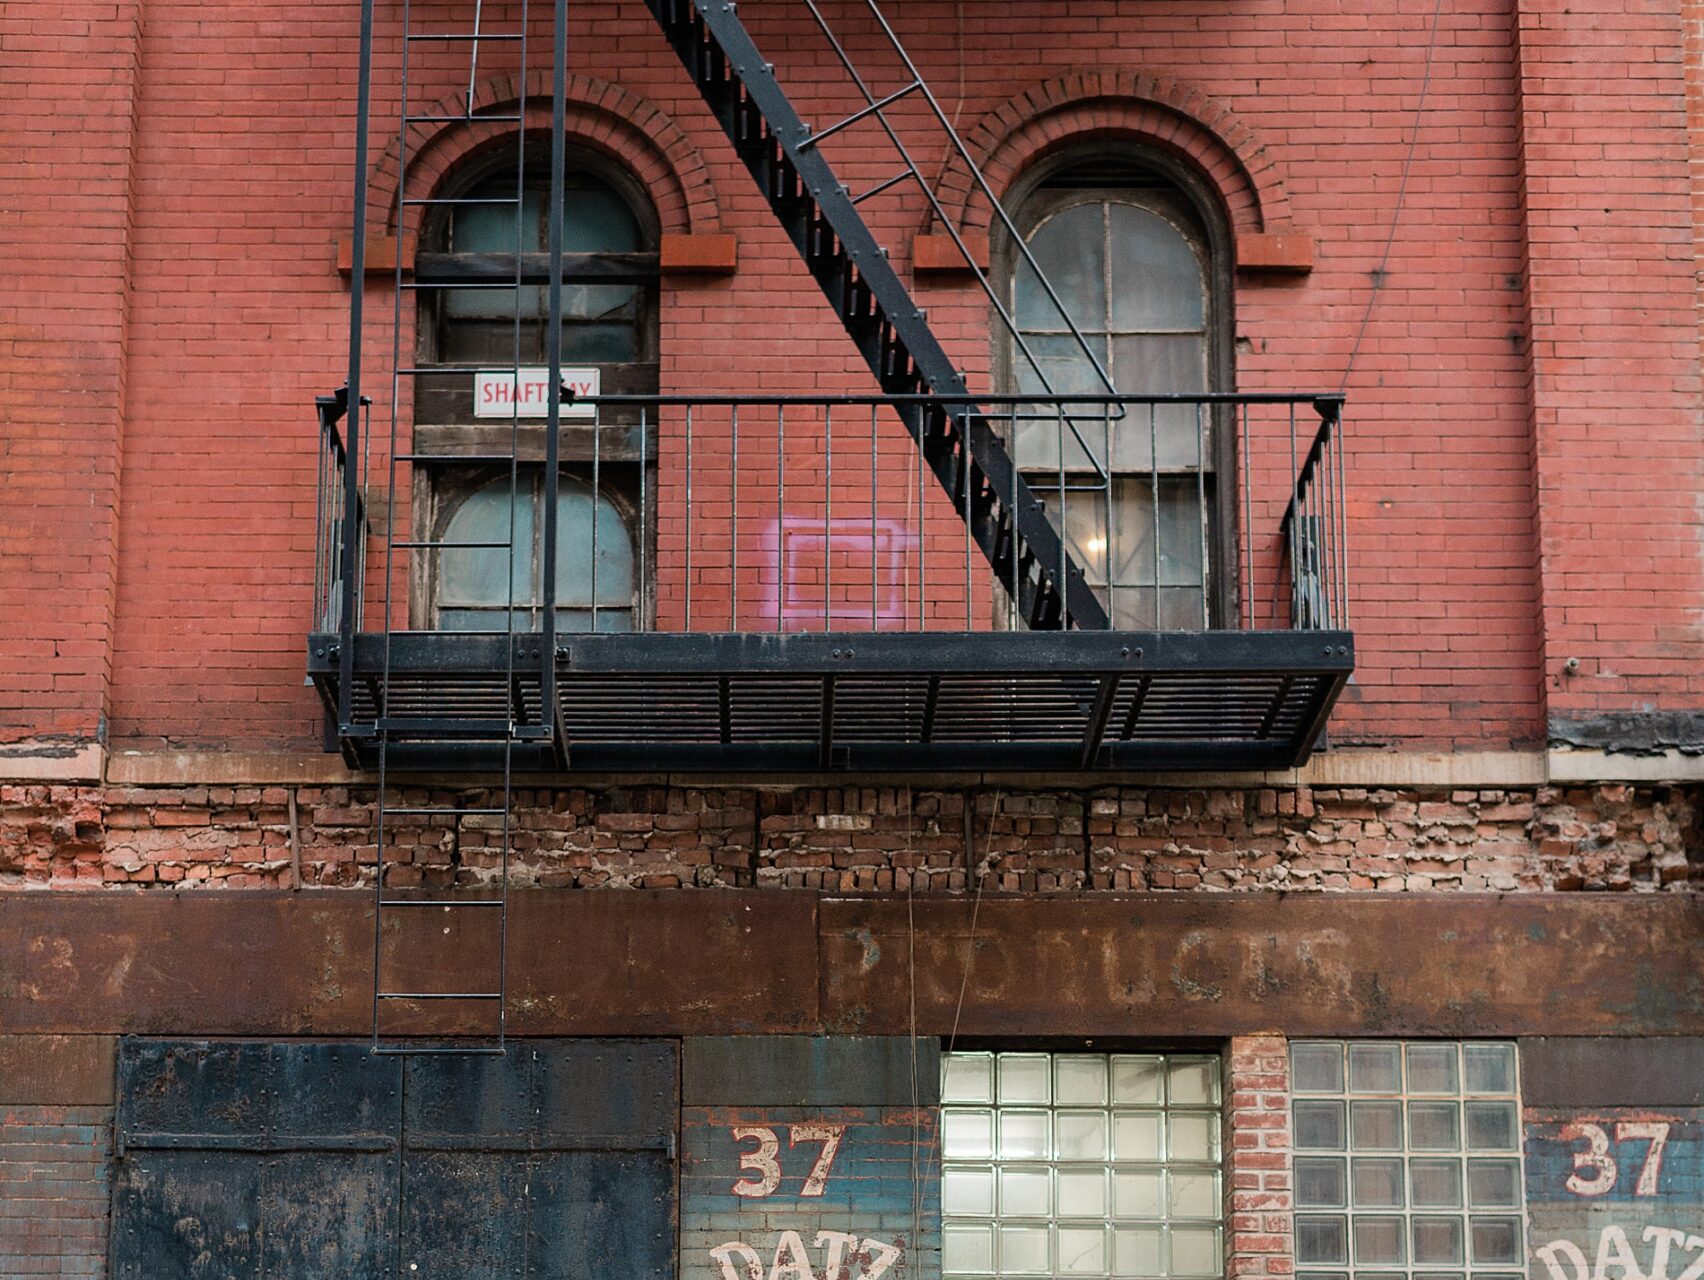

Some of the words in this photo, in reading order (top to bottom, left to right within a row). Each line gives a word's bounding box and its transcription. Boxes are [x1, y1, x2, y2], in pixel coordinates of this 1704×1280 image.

[483, 382, 592, 403] SHAFTAY
[731, 1125, 847, 1199] 37
[1564, 1121, 1671, 1197] 37
